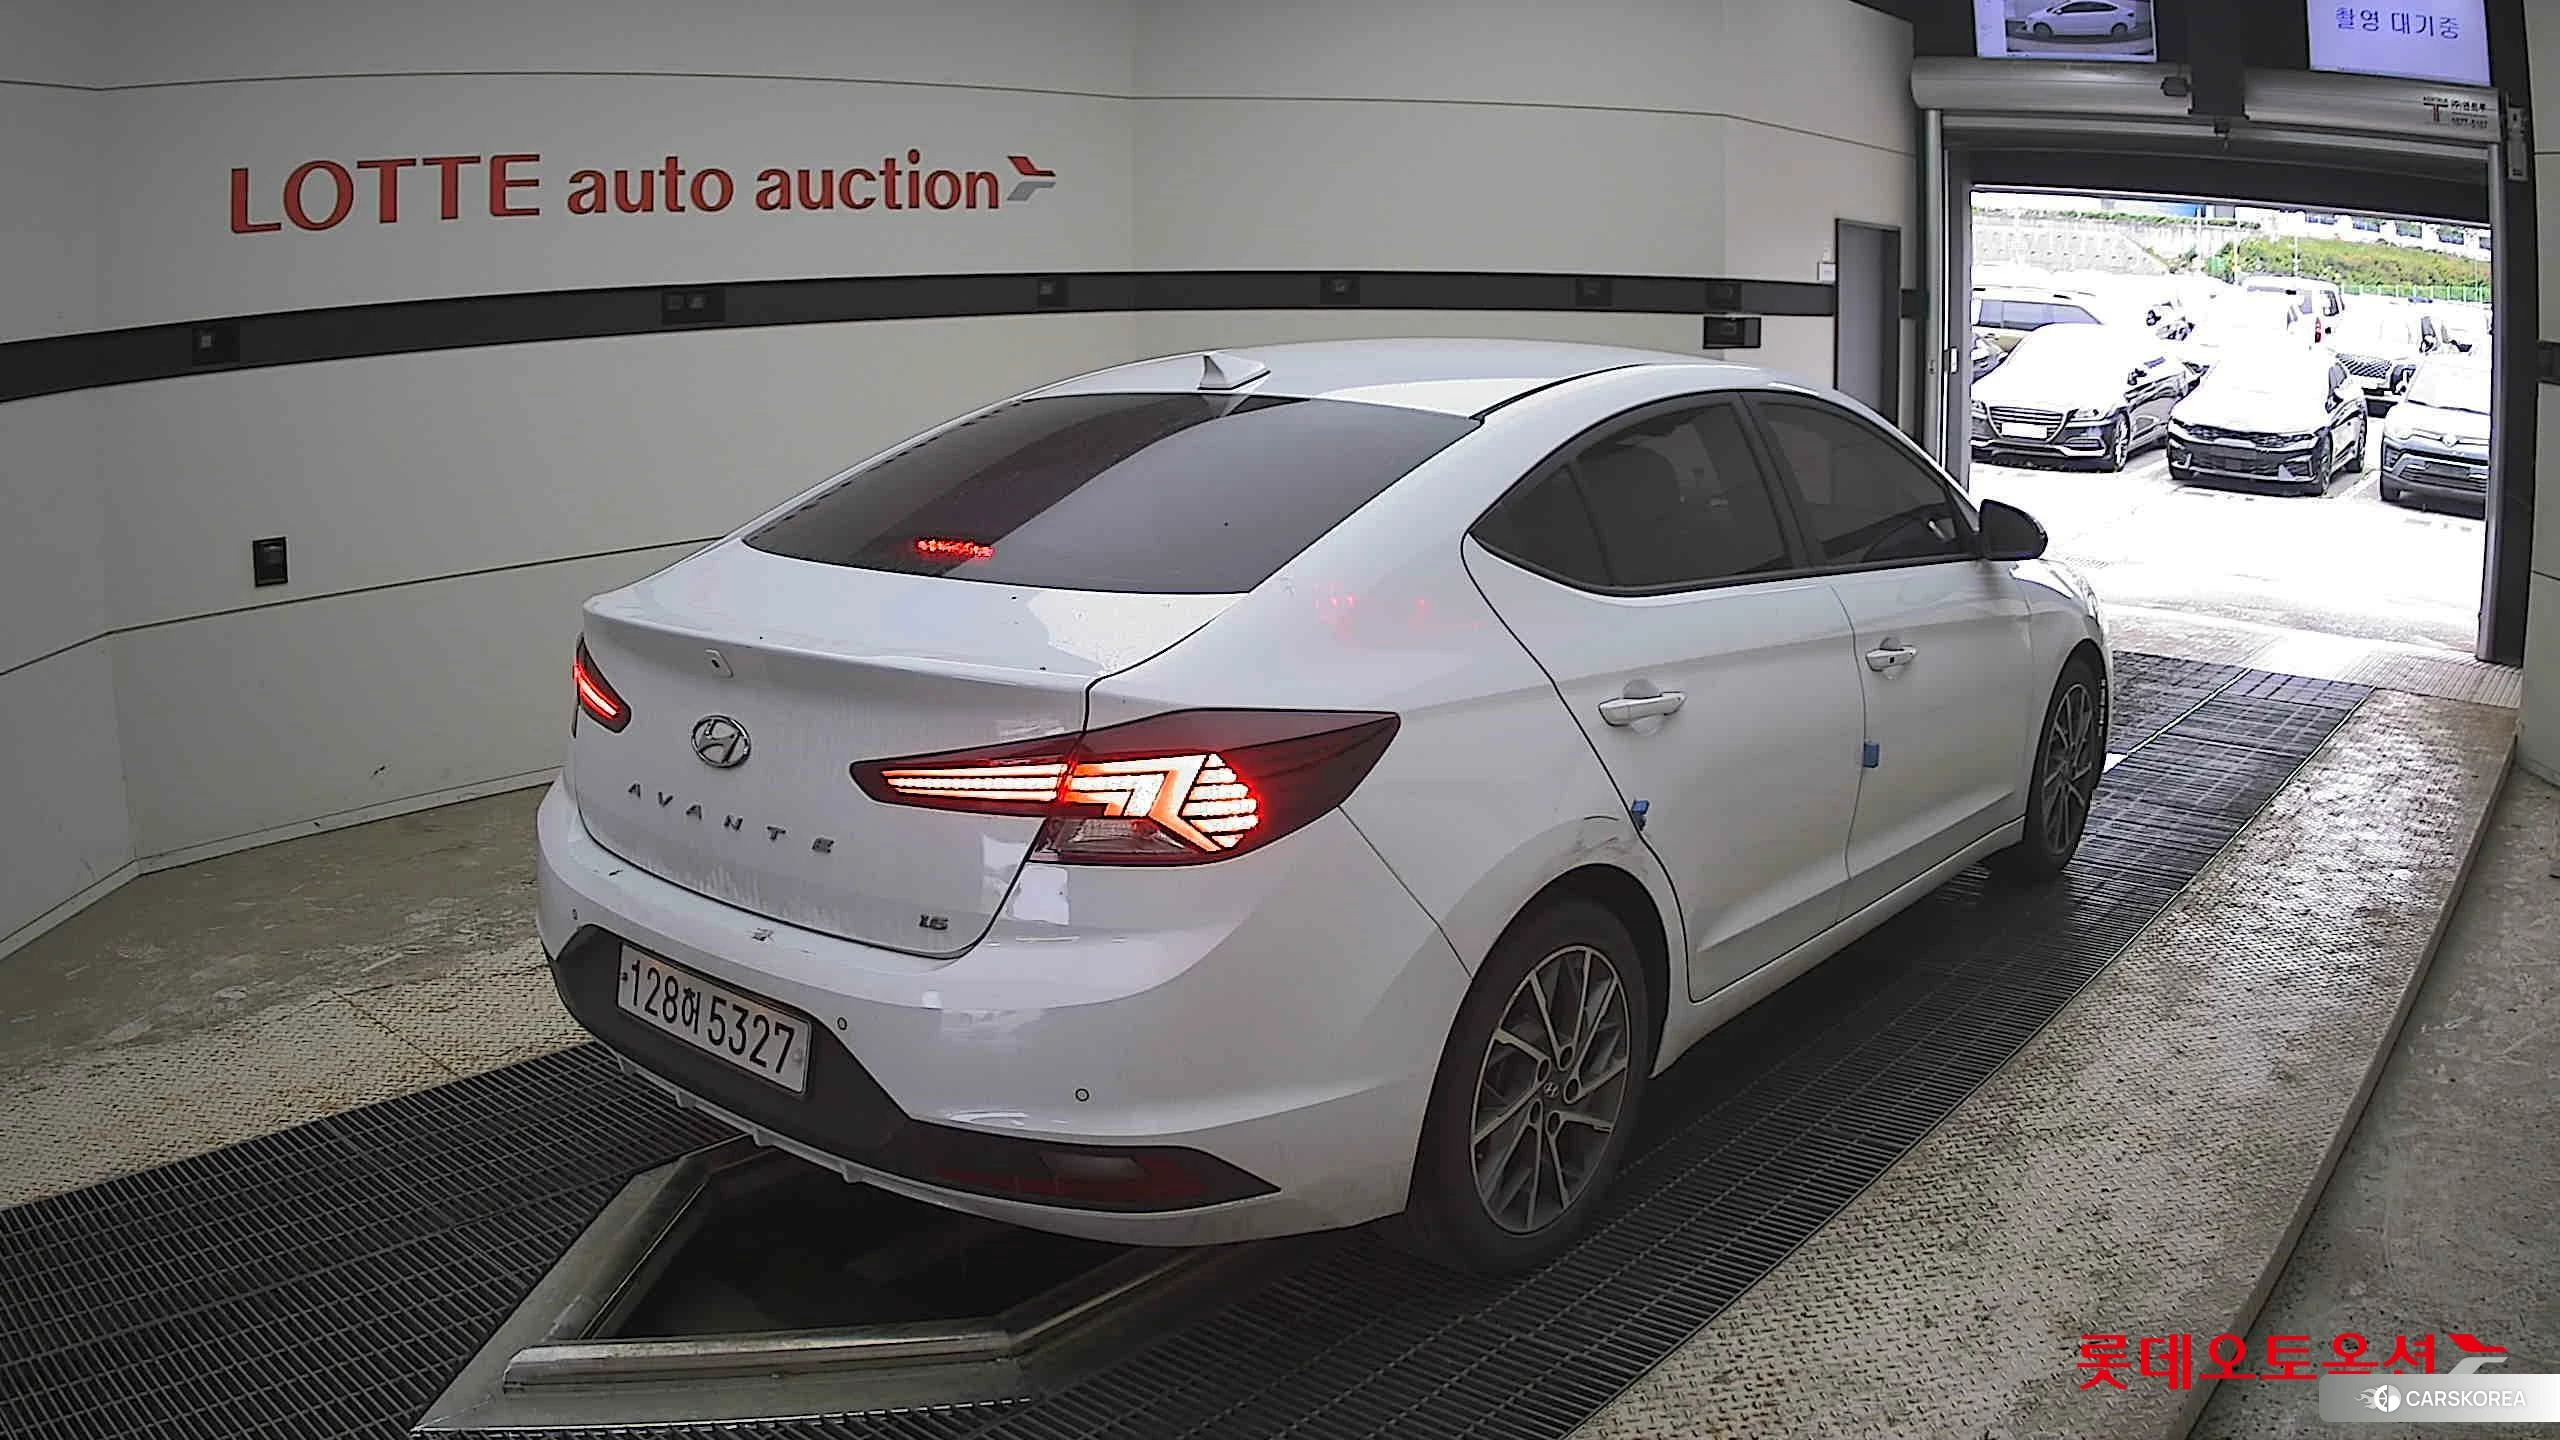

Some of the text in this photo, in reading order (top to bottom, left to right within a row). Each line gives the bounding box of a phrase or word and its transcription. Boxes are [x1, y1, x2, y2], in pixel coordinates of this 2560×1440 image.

[2335, 6, 2460, 40] 촬영 대기중
[230, 148, 1001, 234] LOTTE auto auction
[628, 783, 835, 854] AVANTE
